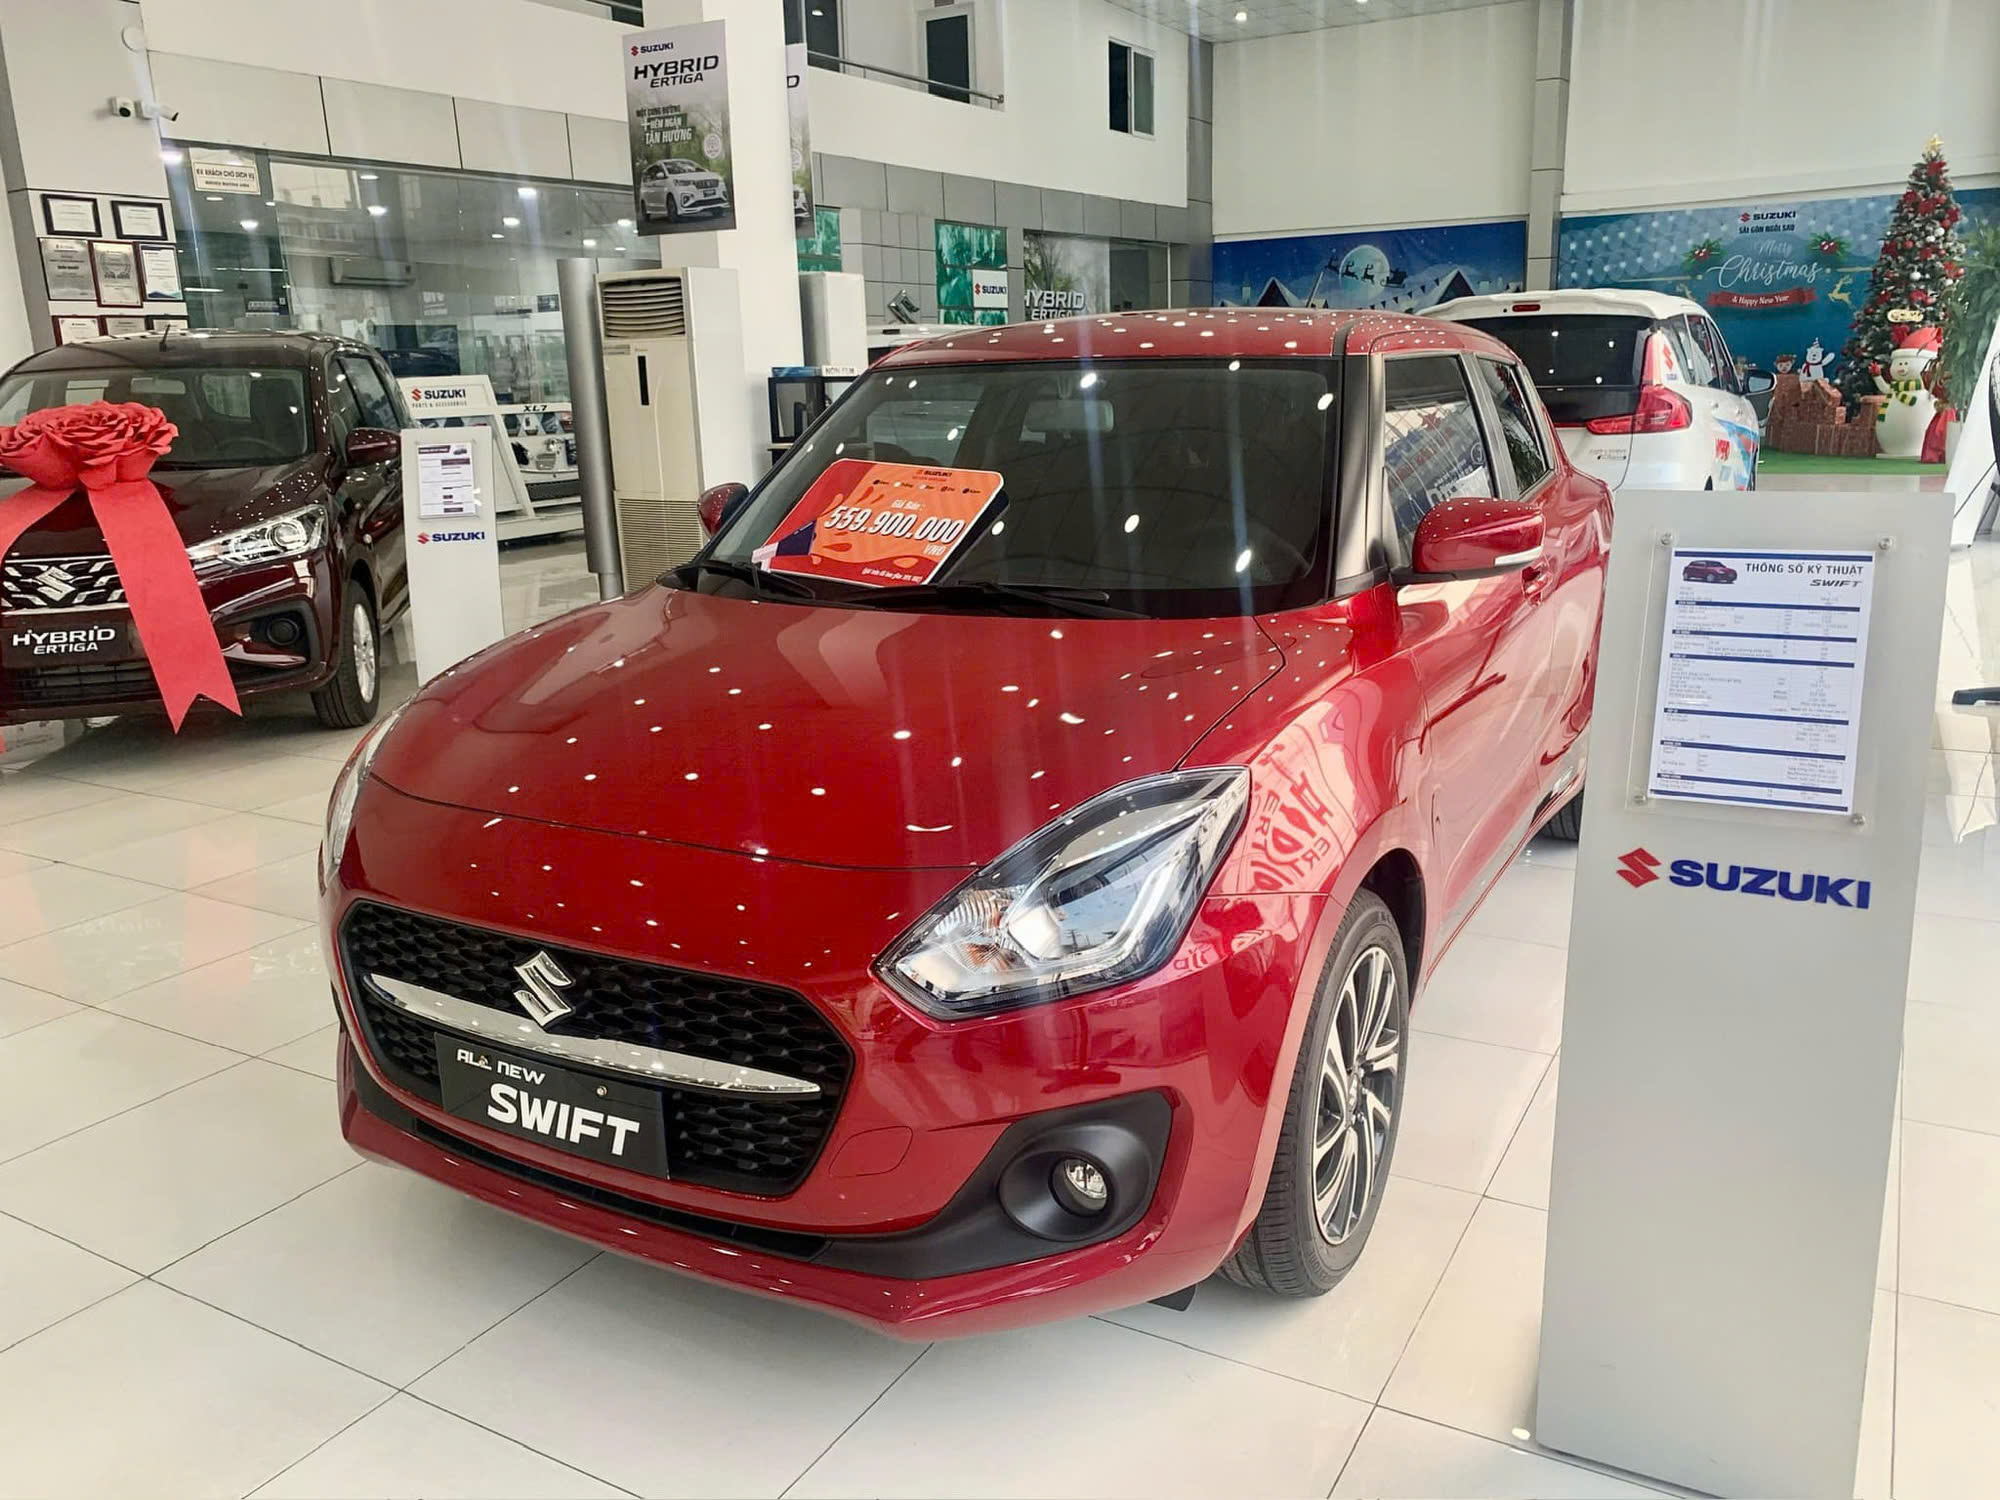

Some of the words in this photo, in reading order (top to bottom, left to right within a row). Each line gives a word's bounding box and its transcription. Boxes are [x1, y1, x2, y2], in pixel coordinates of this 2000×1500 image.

[640, 42, 674, 54] SUZUKI
[634, 55, 719, 80] HYBRID
[650, 72, 704, 88] ERTIGA
[1752, 211, 1797, 221] SUZUKI
[1750, 224, 1764, 234] GÒN
[1782, 224, 1795, 232] SAO
[1706, 255, 1822, 288] Christmas
[981, 285, 1007, 295] SUZUKI
[1738, 296, 1758, 307] Happy
[1759, 296, 1774, 304] New
[1775, 295, 1790, 303] Year
[424, 389, 466, 400] SUZUKI
[823, 505, 965, 545] 559.900.000
[432, 531, 485, 542] SUZUKI
[1745, 562, 1784, 573] THÔNG
[1788, 561, 1806, 574] SỐ
[1807, 562, 1823, 574] KỸ
[1826, 564, 1864, 577] THUẬT
[1809, 579, 1862, 588] SWIFT
[12, 628, 116, 646] HYBRID
[33, 642, 98, 655] ERTIGA
[1669, 859, 1871, 910] SUZUKI
[457, 1049, 492, 1070] ALL
[496, 1060, 547, 1085] NEW
[487, 1082, 640, 1156] SWIFT
